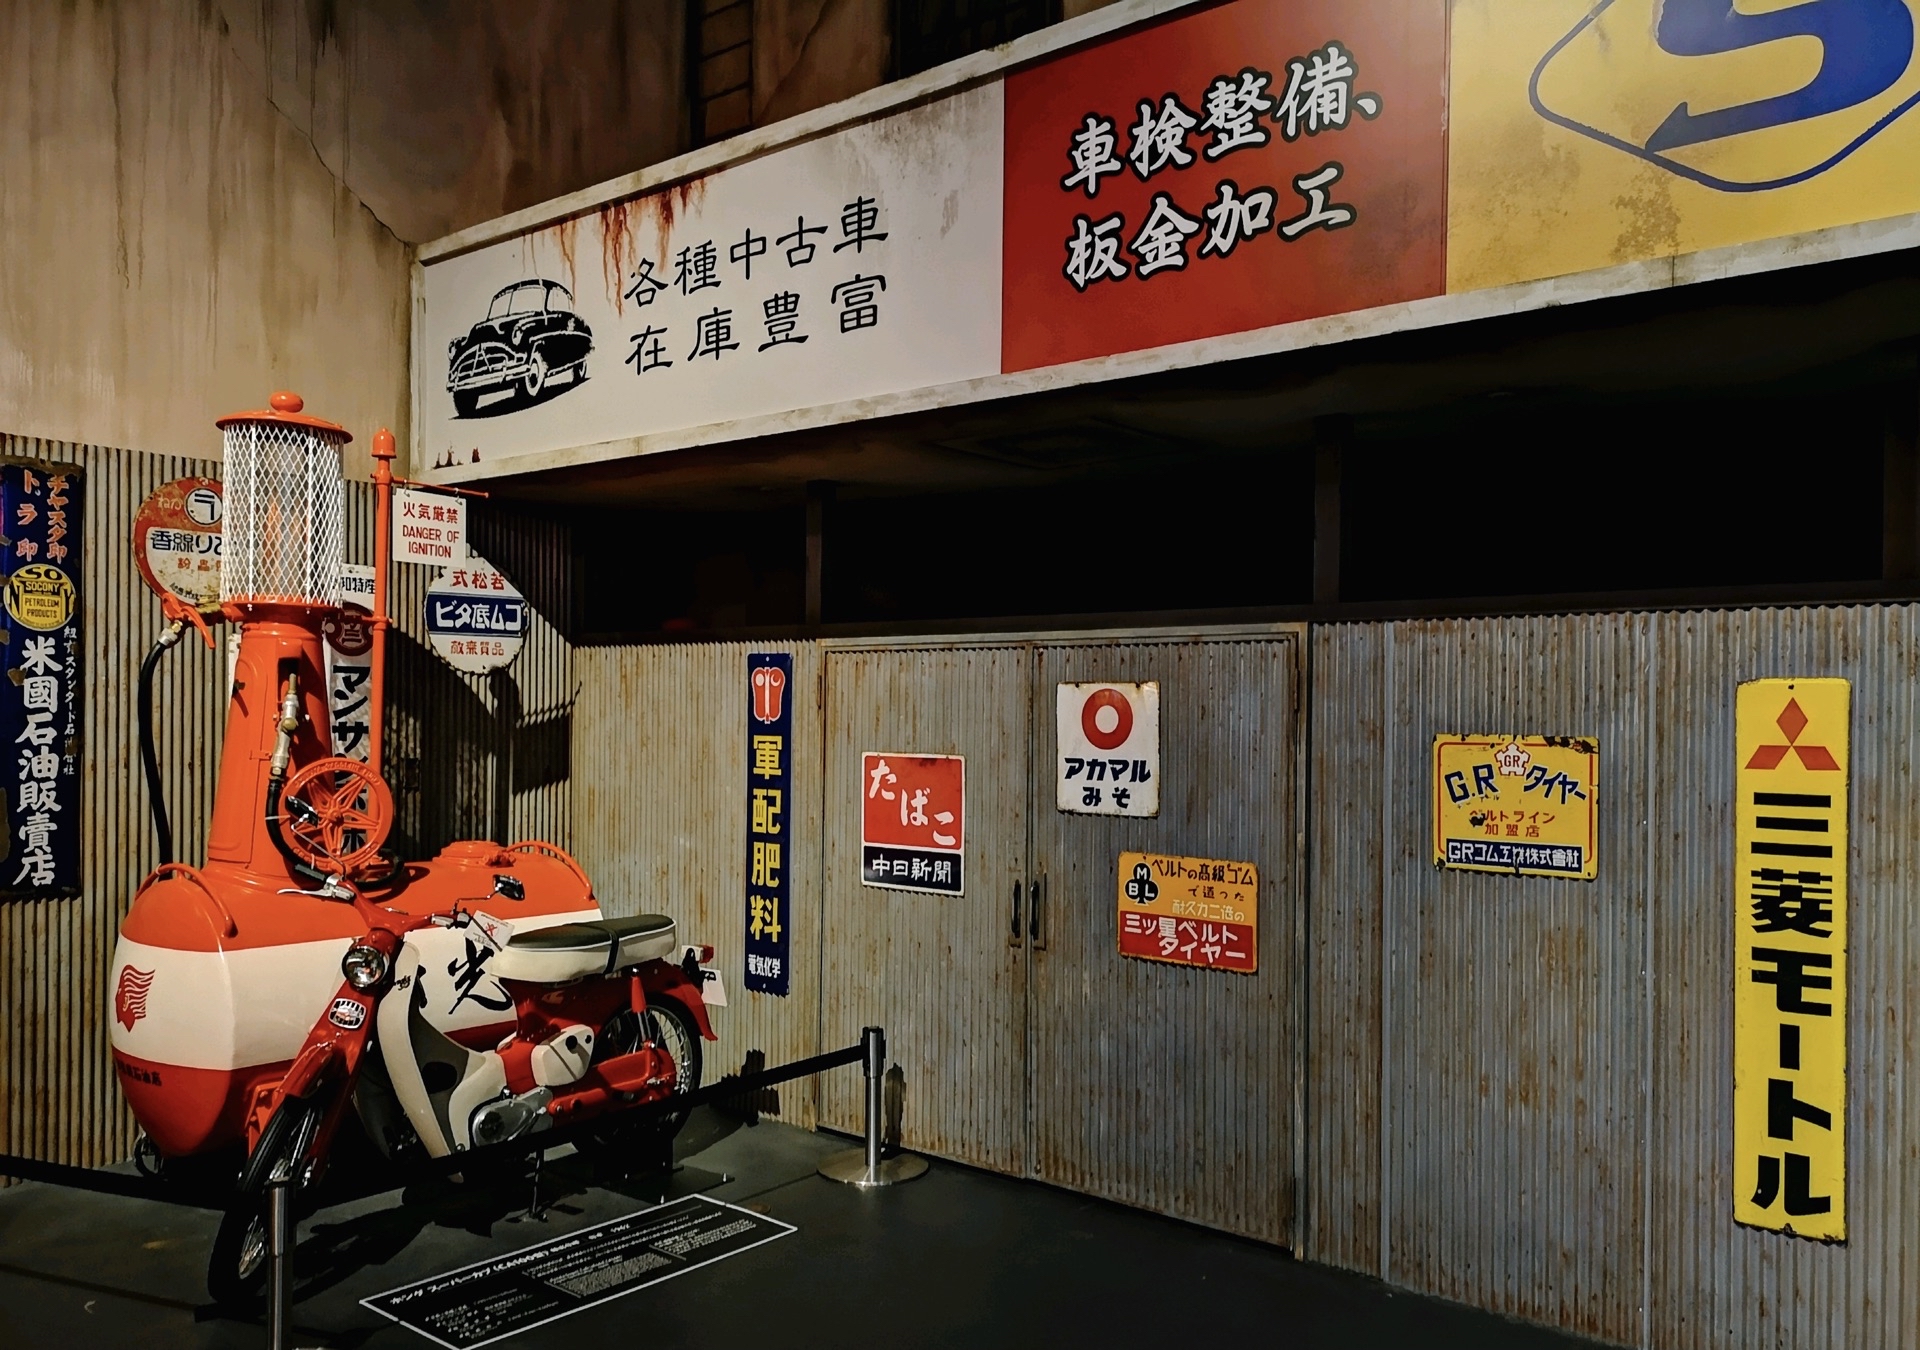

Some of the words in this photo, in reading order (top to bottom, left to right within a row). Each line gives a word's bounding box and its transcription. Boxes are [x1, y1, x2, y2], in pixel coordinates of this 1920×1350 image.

[1065, 166, 1352, 289] 板金加工
[623, 195, 889, 308] 各種中古車
[624, 273, 887, 376] 在庫豊富
[403, 502, 459, 524] 火気厳禁
[402, 525, 442, 542] DANGER
[446, 530, 460, 543] OF
[408, 541, 452, 558] IGNITION
[25, 581, 59, 592] SOCONY
[25, 597, 60, 608] PETROLEUM
[27, 608, 58, 618] PRODUCTS
[13, 636, 63, 887] 米國石油販賣店
[1064, 757, 1151, 783] アカマル
[1503, 755, 1521, 768] GR
[869, 759, 956, 846] たばこ
[1082, 786, 1131, 809] みそ
[750, 735, 783, 942] 軍配肥料
[1484, 823, 1540, 837] 加盟店
[872, 853, 952, 884] 中日新聞
[1124, 913, 1238, 945] 三ツ星ベルト
[1159, 937, 1246, 963] タイヤー
[1751, 791, 1833, 1217] 三菱モートル
